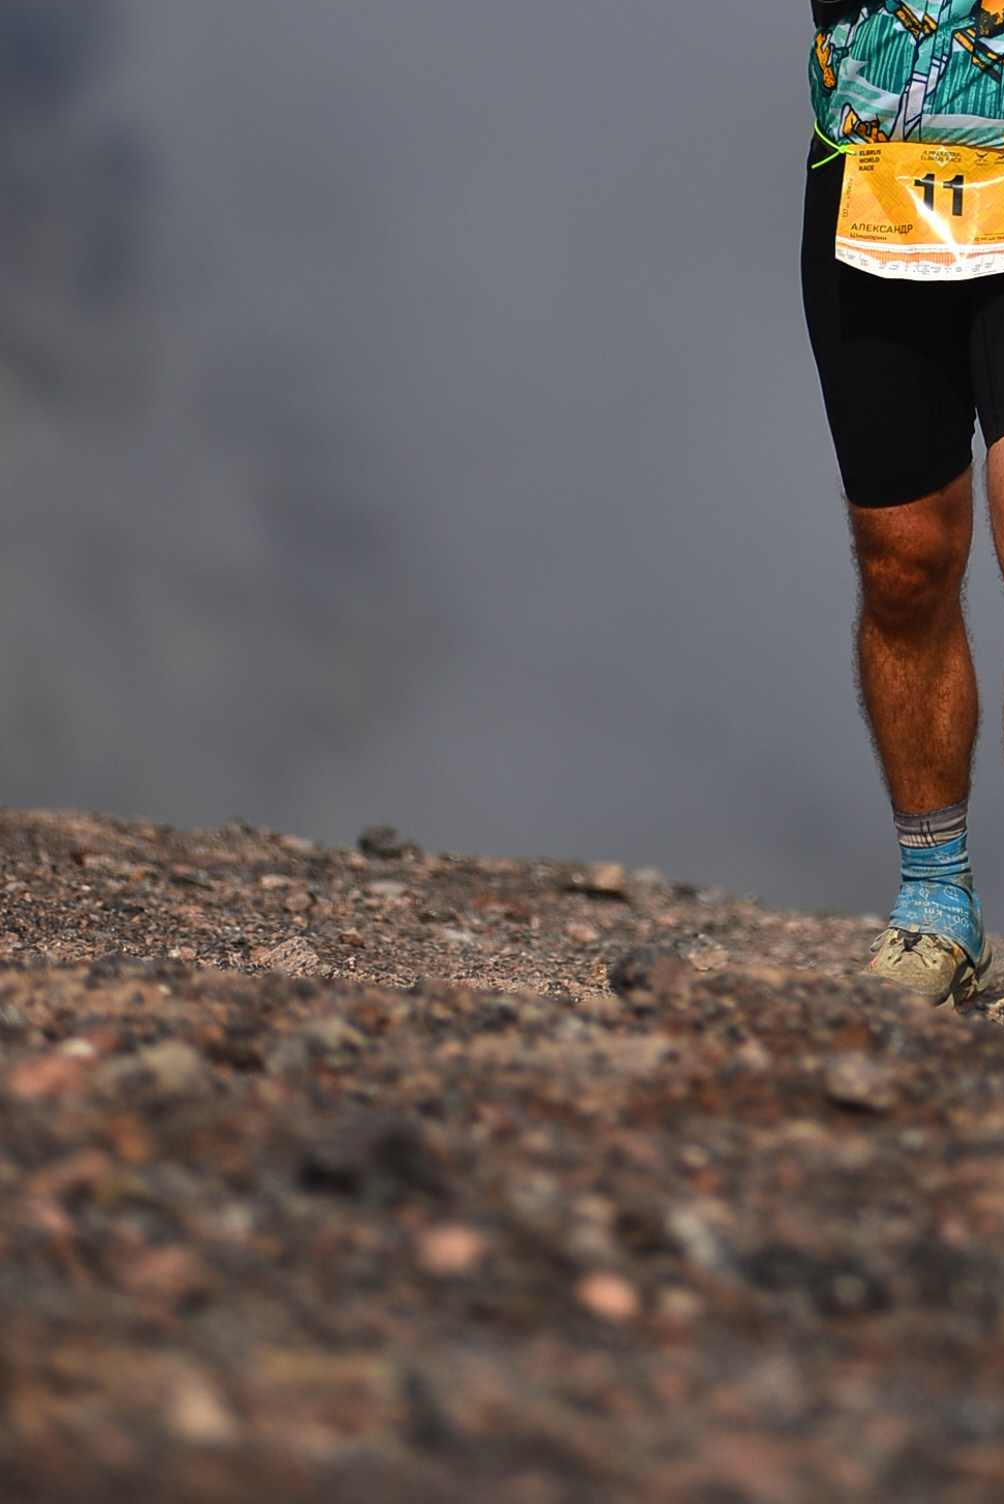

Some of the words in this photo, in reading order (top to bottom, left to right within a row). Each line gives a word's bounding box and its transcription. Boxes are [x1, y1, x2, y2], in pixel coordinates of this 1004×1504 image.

[858, 164, 874, 172] RACE
[914, 173, 964, 217] 11
[851, 222, 914, 235] АЛЕКСАНДР
